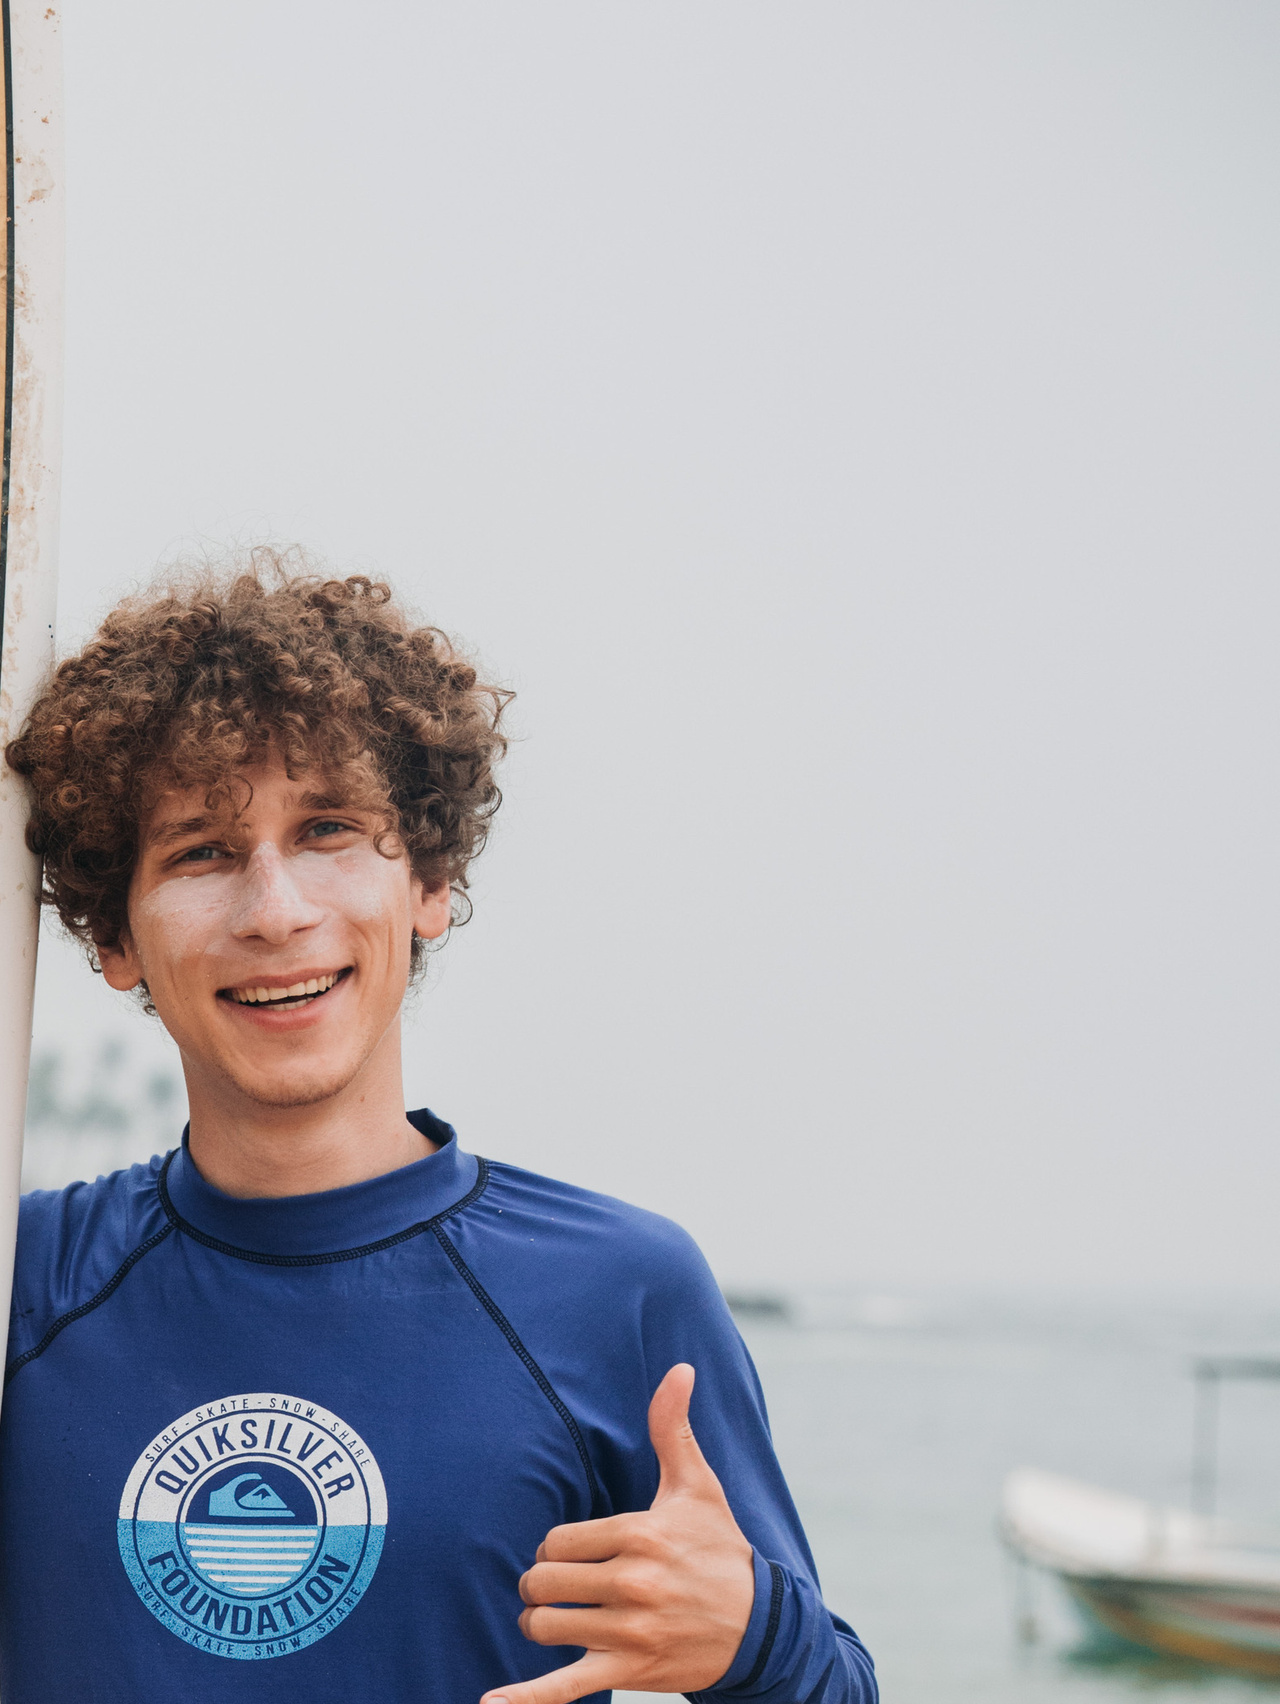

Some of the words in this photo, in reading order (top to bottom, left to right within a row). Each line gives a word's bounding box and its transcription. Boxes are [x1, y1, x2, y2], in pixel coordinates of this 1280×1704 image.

[145, 1427, 179, 1462] SURF
[195, 1398, 249, 1422] SKATE
[269, 1397, 317, 1419] SNOW
[330, 1422, 371, 1468] SHARE
[155, 1419, 355, 1499] QUIKSILVER
[137, 1581, 169, 1618] SURF
[181, 1626, 235, 1655] SKATE
[254, 1636, 301, 1656] SNOW
[317, 1587, 361, 1634] SHARE
[147, 1550, 351, 1636] FOUNDATION
